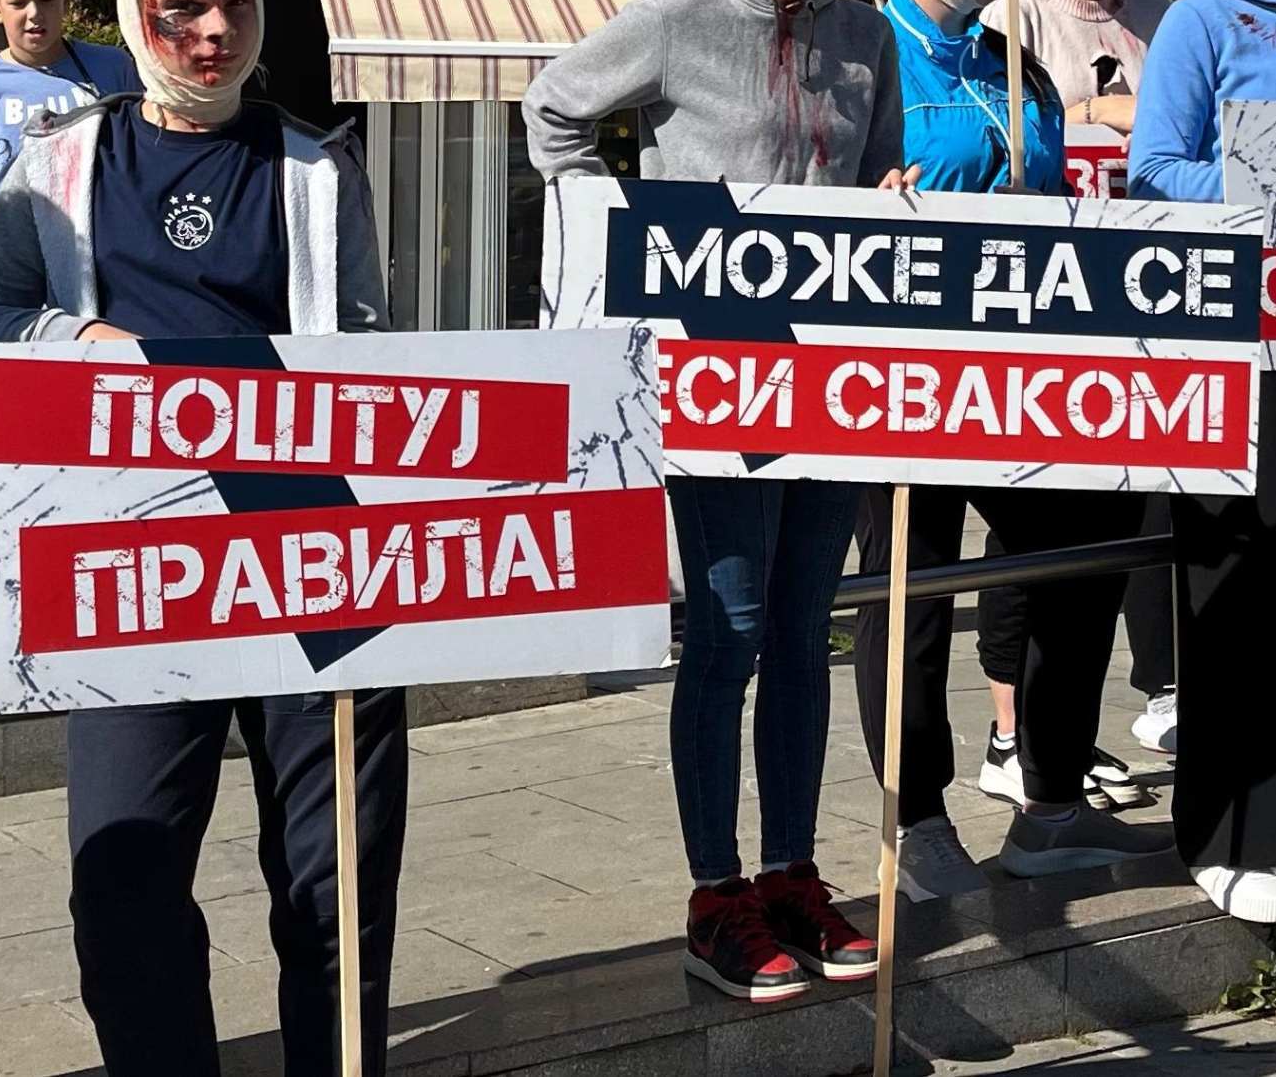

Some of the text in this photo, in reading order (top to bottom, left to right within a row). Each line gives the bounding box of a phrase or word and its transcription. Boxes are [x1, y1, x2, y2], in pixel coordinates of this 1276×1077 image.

[644, 225, 1235, 324] МОЖЕ ДА СЕ
[89, 374, 481, 469] ПОШТУЈ
[825, 360, 1224, 443] СВАКОМ!
[73, 509, 576, 638] ПРАВИЛА!
